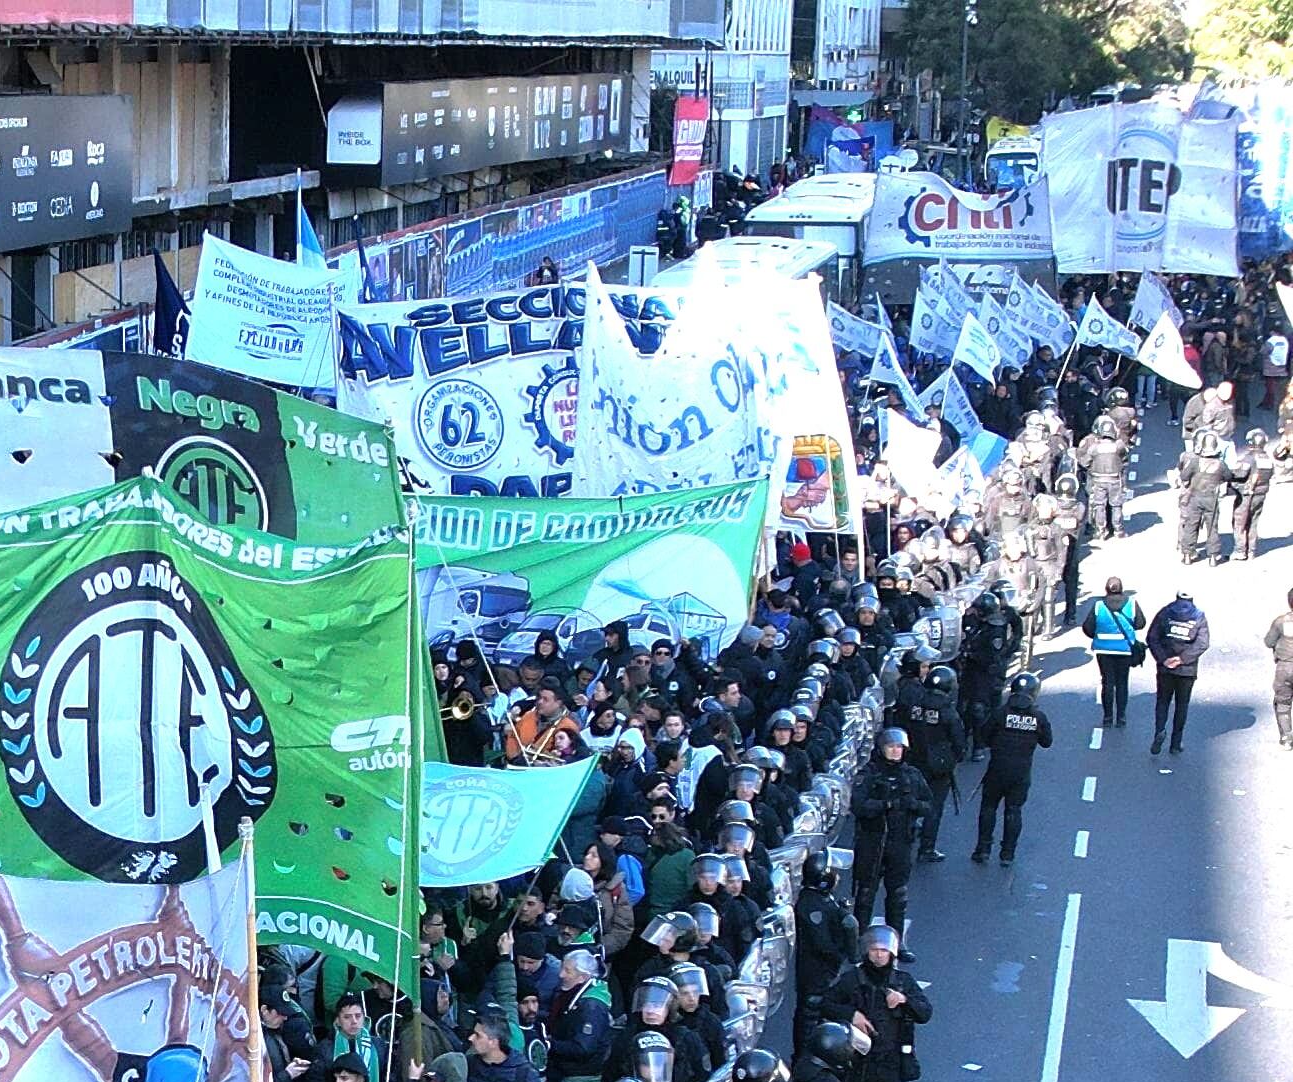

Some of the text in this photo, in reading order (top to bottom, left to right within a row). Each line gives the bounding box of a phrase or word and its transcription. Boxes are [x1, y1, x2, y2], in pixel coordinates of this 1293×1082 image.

[663, 70, 706, 84] ALQUILR
[212, 290, 242, 307] AFINES
[243, 302, 254, 311] DE
[272, 282, 330, 297] TRABAJADORE
[136, 376, 261, 433] Negra
[293, 415, 390, 468] Verde
[441, 401, 486, 447] 62
[433, 437, 497, 465] PERONISTAS
[237, 541, 282, 568] del
[81, 565, 132, 603] 100
[47, 618, 219, 819] ATE
[254, 909, 381, 964] ACIONAL
